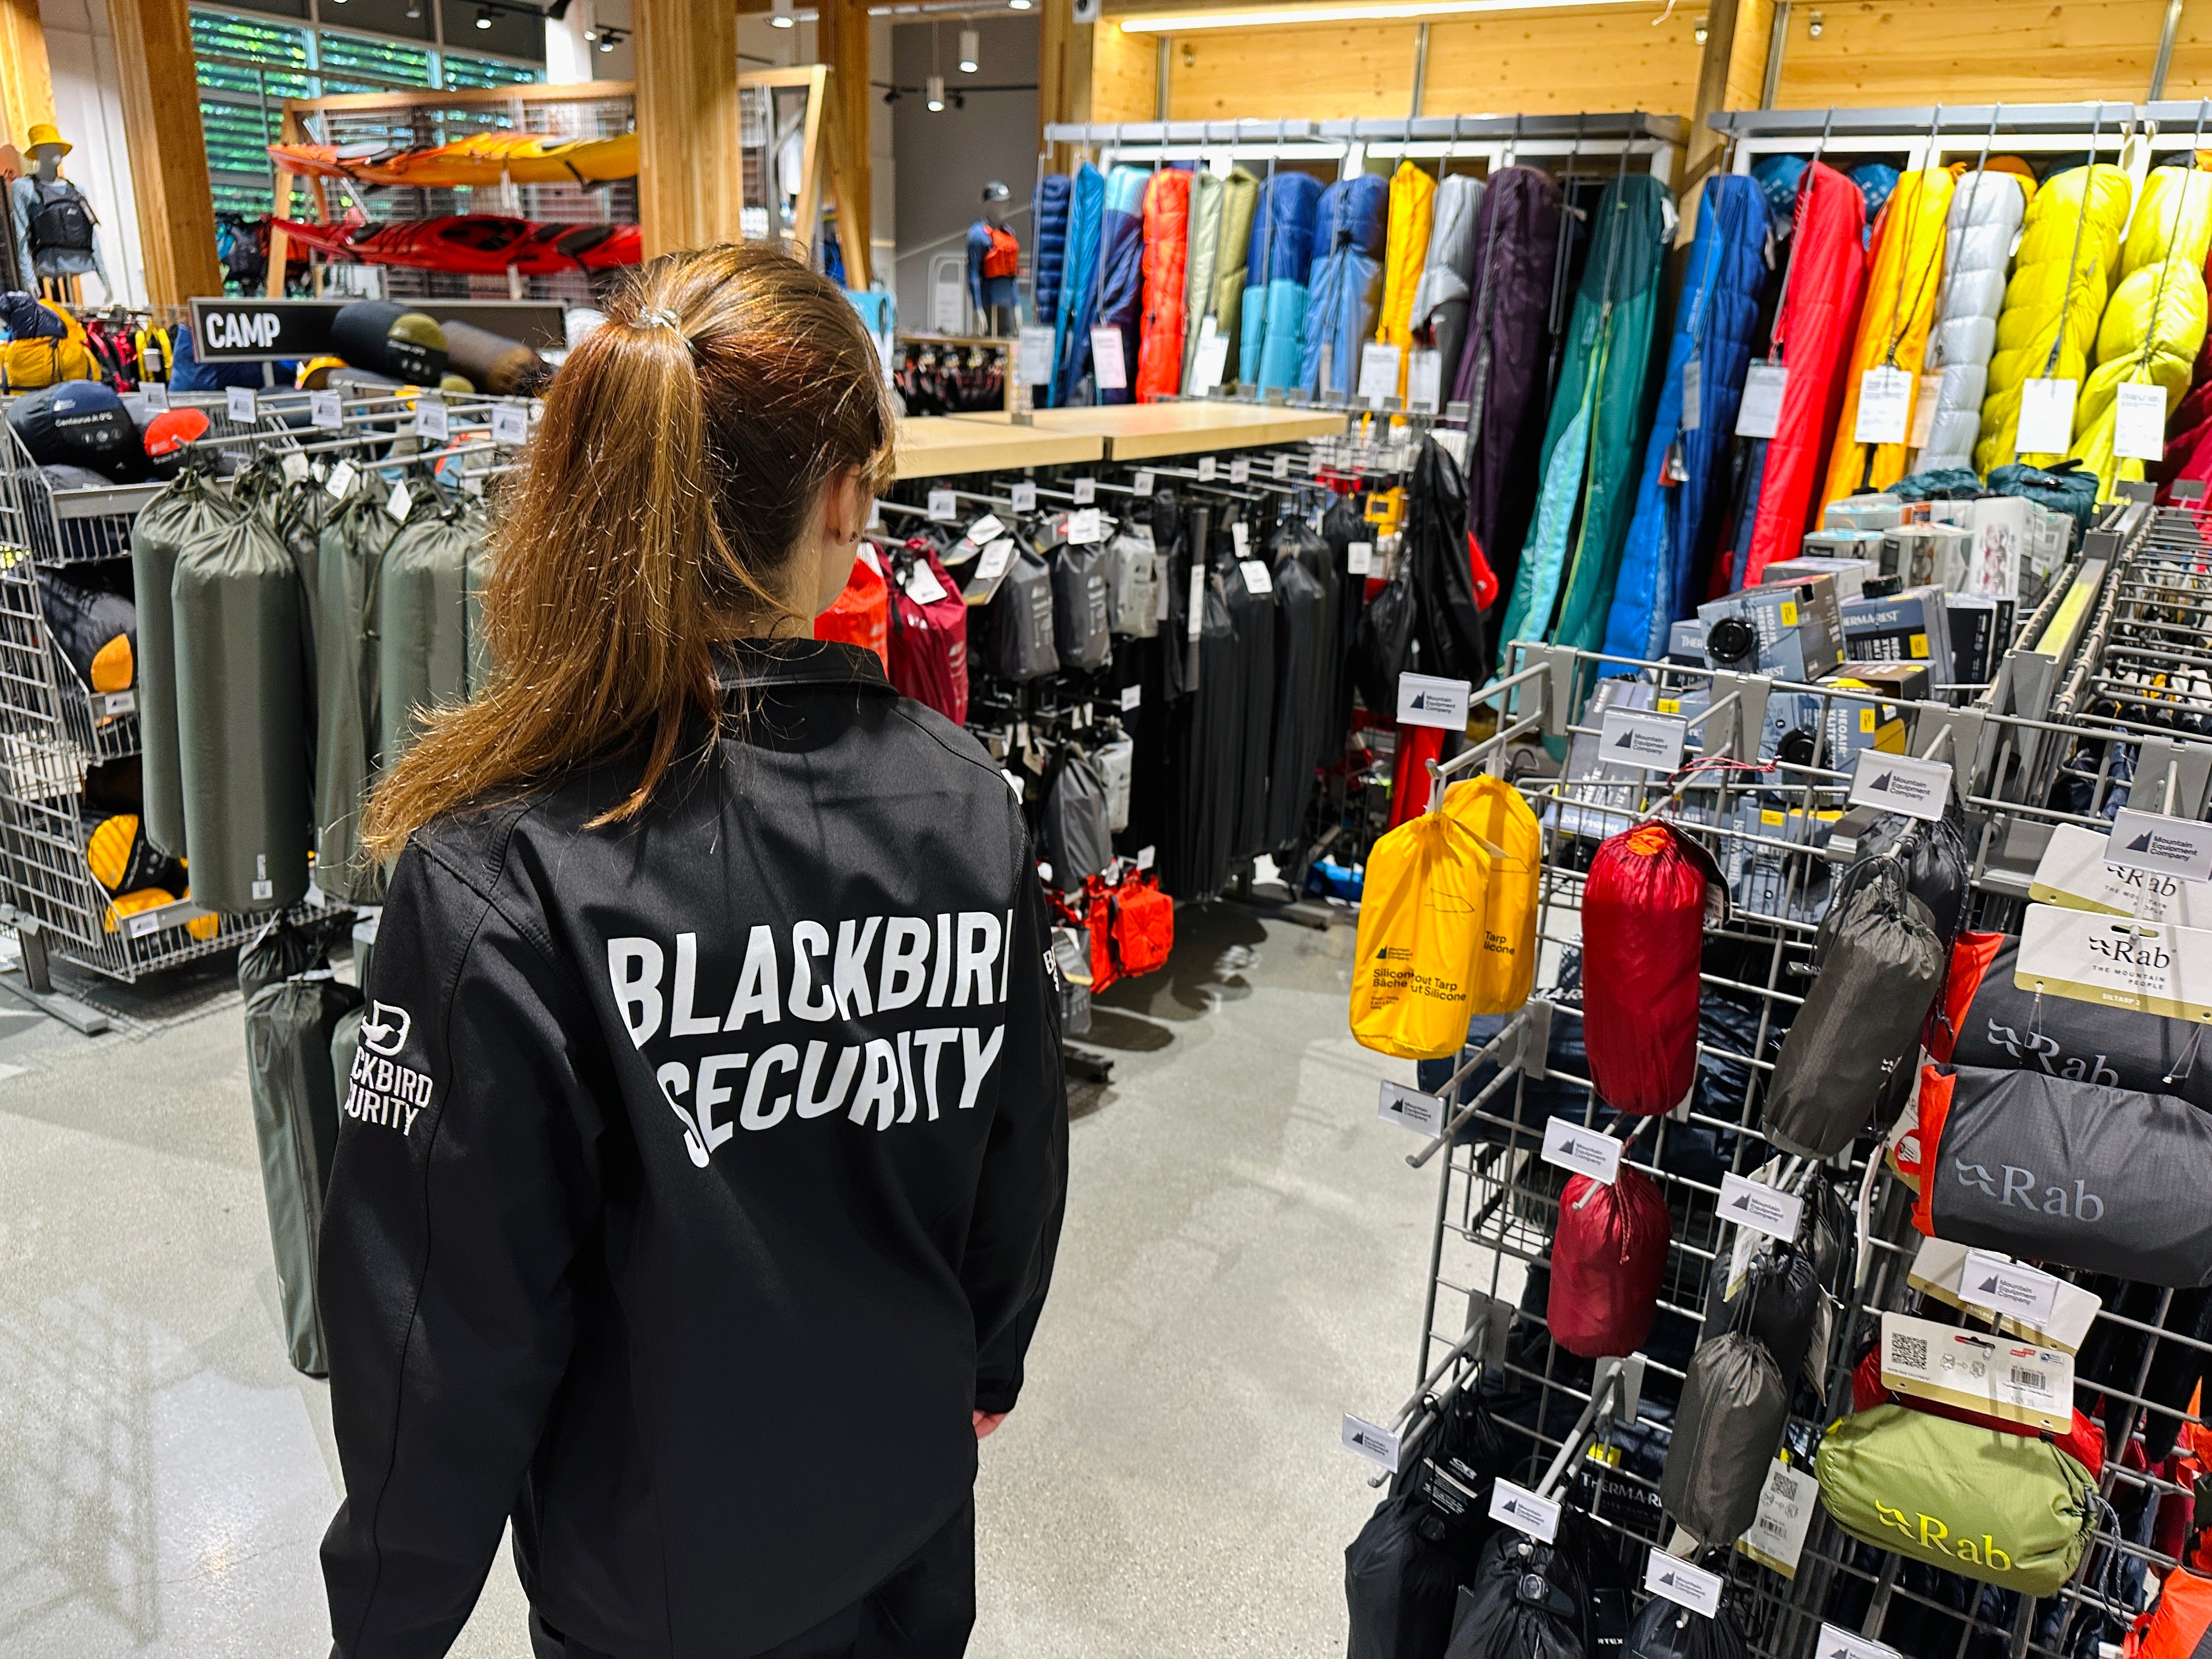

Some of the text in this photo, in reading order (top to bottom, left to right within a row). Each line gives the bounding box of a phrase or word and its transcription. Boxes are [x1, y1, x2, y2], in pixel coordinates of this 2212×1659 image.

[206, 312, 280, 348] CAMP
[1426, 701, 1455, 709] Equipment
[1633, 739, 1668, 749] Equipment
[1634, 733, 1664, 743] Mountain
[1633, 744, 1663, 755] Company
[1891, 782, 1931, 795] Equipment
[1893, 775, 1927, 788] Mountain
[1890, 787, 1925, 802] Company
[2152, 842, 2198, 856] Equipment
[2154, 836, 2193, 849] Mountain
[2149, 848, 2191, 862] Company
[2104, 885, 2120, 894] THE
[1486, 930, 1506, 945] Tarp
[1483, 940, 1515, 955] licone
[2111, 939, 2170, 969] Rab
[607, 909, 1013, 1050] BLACKBIR
[2115, 969, 2165, 983] MOUNTAIN
[1373, 977, 1407, 988] Bâche
[1424, 986, 1466, 1001] Silicone
[1415, 975, 1432, 986] out
[1435, 978, 1458, 992] Tarp
[2128, 979, 2164, 990] PEOPLE
[2028, 1031, 2119, 1088] Rab
[351, 1046, 433, 1108] CKBIRD
[656, 1024, 1006, 1168] SECURITY
[345, 1080, 419, 1136] URITY
[1404, 1106, 1431, 1118] Equipment
[1405, 1101, 1427, 1112] Mountain
[1404, 1111, 1427, 1122] Company
[1576, 1143, 1602, 1155] Mountain
[1576, 1148, 1606, 1162] Equipment
[1575, 1153, 1601, 1166] Company
[1999, 1164, 2104, 1222] Rab
[1751, 1203, 1784, 1218] Equipment
[1752, 1198, 1781, 1212] Mountain
[1750, 1208, 1779, 1222] Company
[1999, 1279, 2032, 1293] Mountain
[1999, 1284, 2036, 1301] Equipment
[1997, 1290, 2031, 1305] Company
[1517, 1508, 1544, 1523] Equipment
[1519, 1503, 1542, 1517] Mountain
[1516, 1511, 1541, 1526] Company
[1916, 1512, 2011, 1571] Rab
[1675, 1580, 1706, 1596] Equipment
[1676, 1575, 1702, 1589] Mountain
[1674, 1584, 1702, 1599] Company
